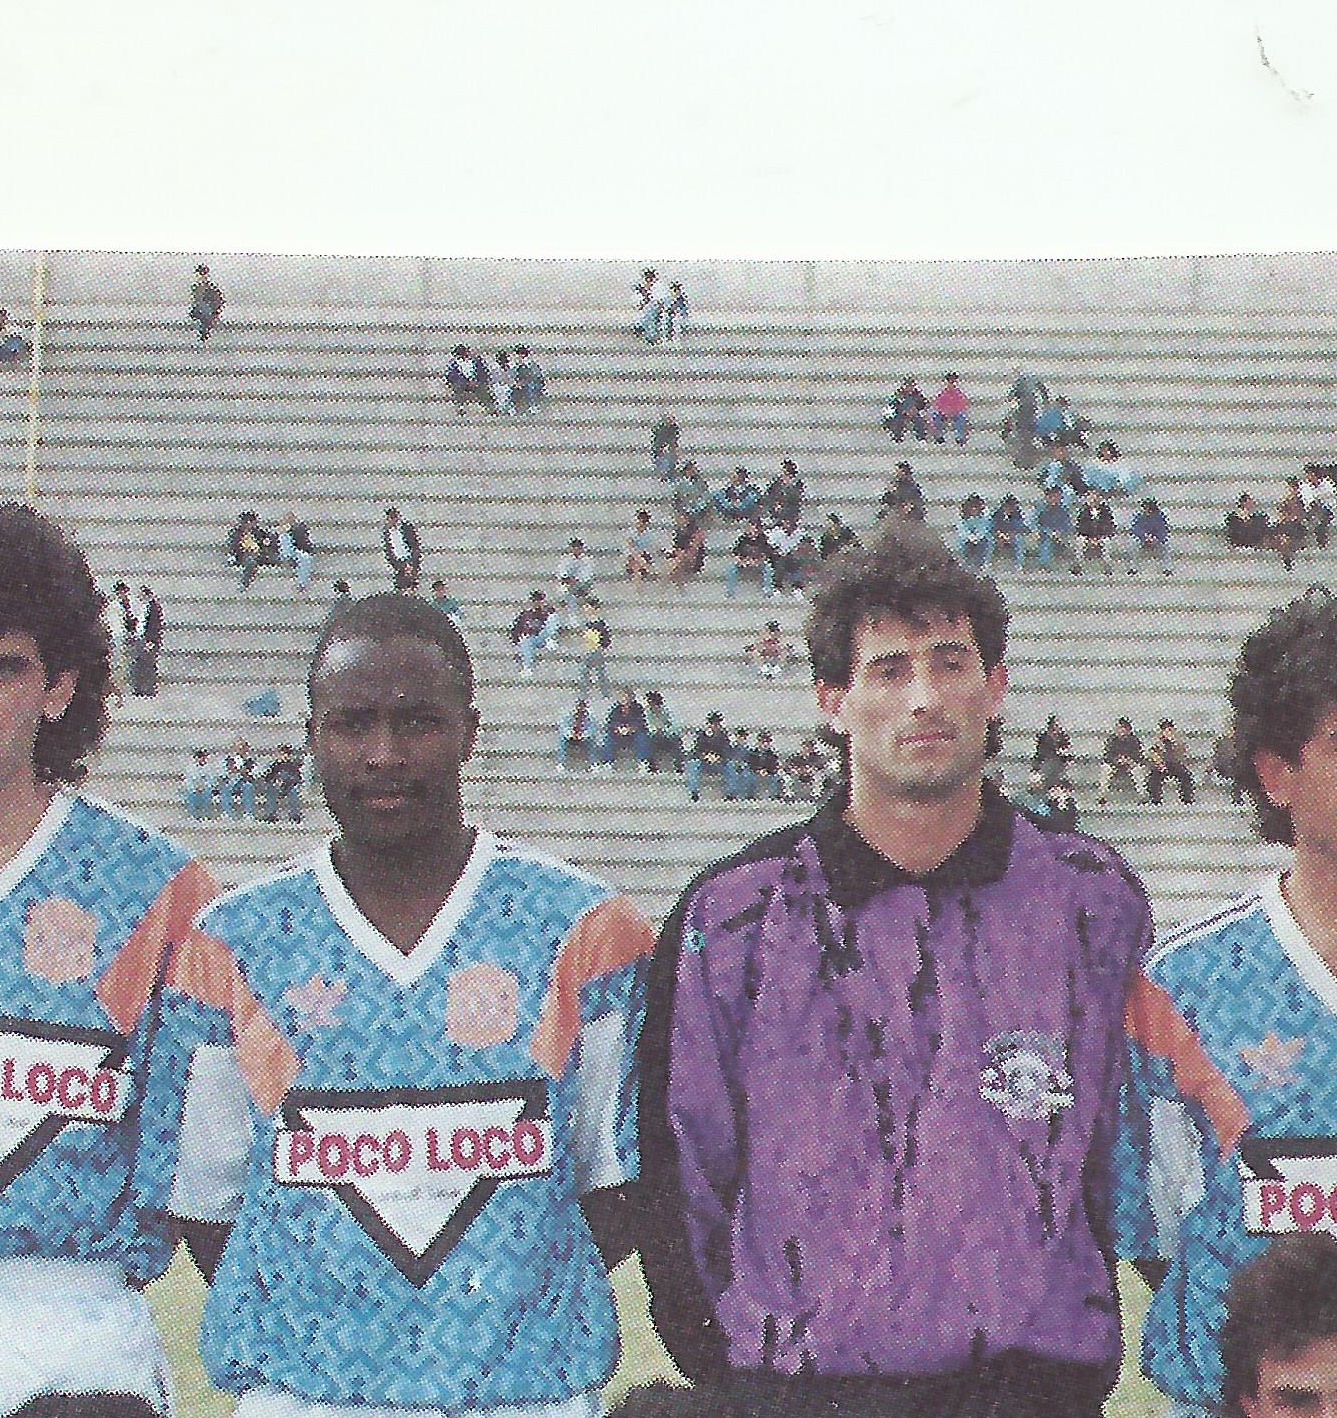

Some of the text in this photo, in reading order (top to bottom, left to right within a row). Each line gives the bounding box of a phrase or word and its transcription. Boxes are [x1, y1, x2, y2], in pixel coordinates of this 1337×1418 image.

[1, 1056, 118, 1113] LOCO
[287, 1119, 546, 1178] POCO LOCO
